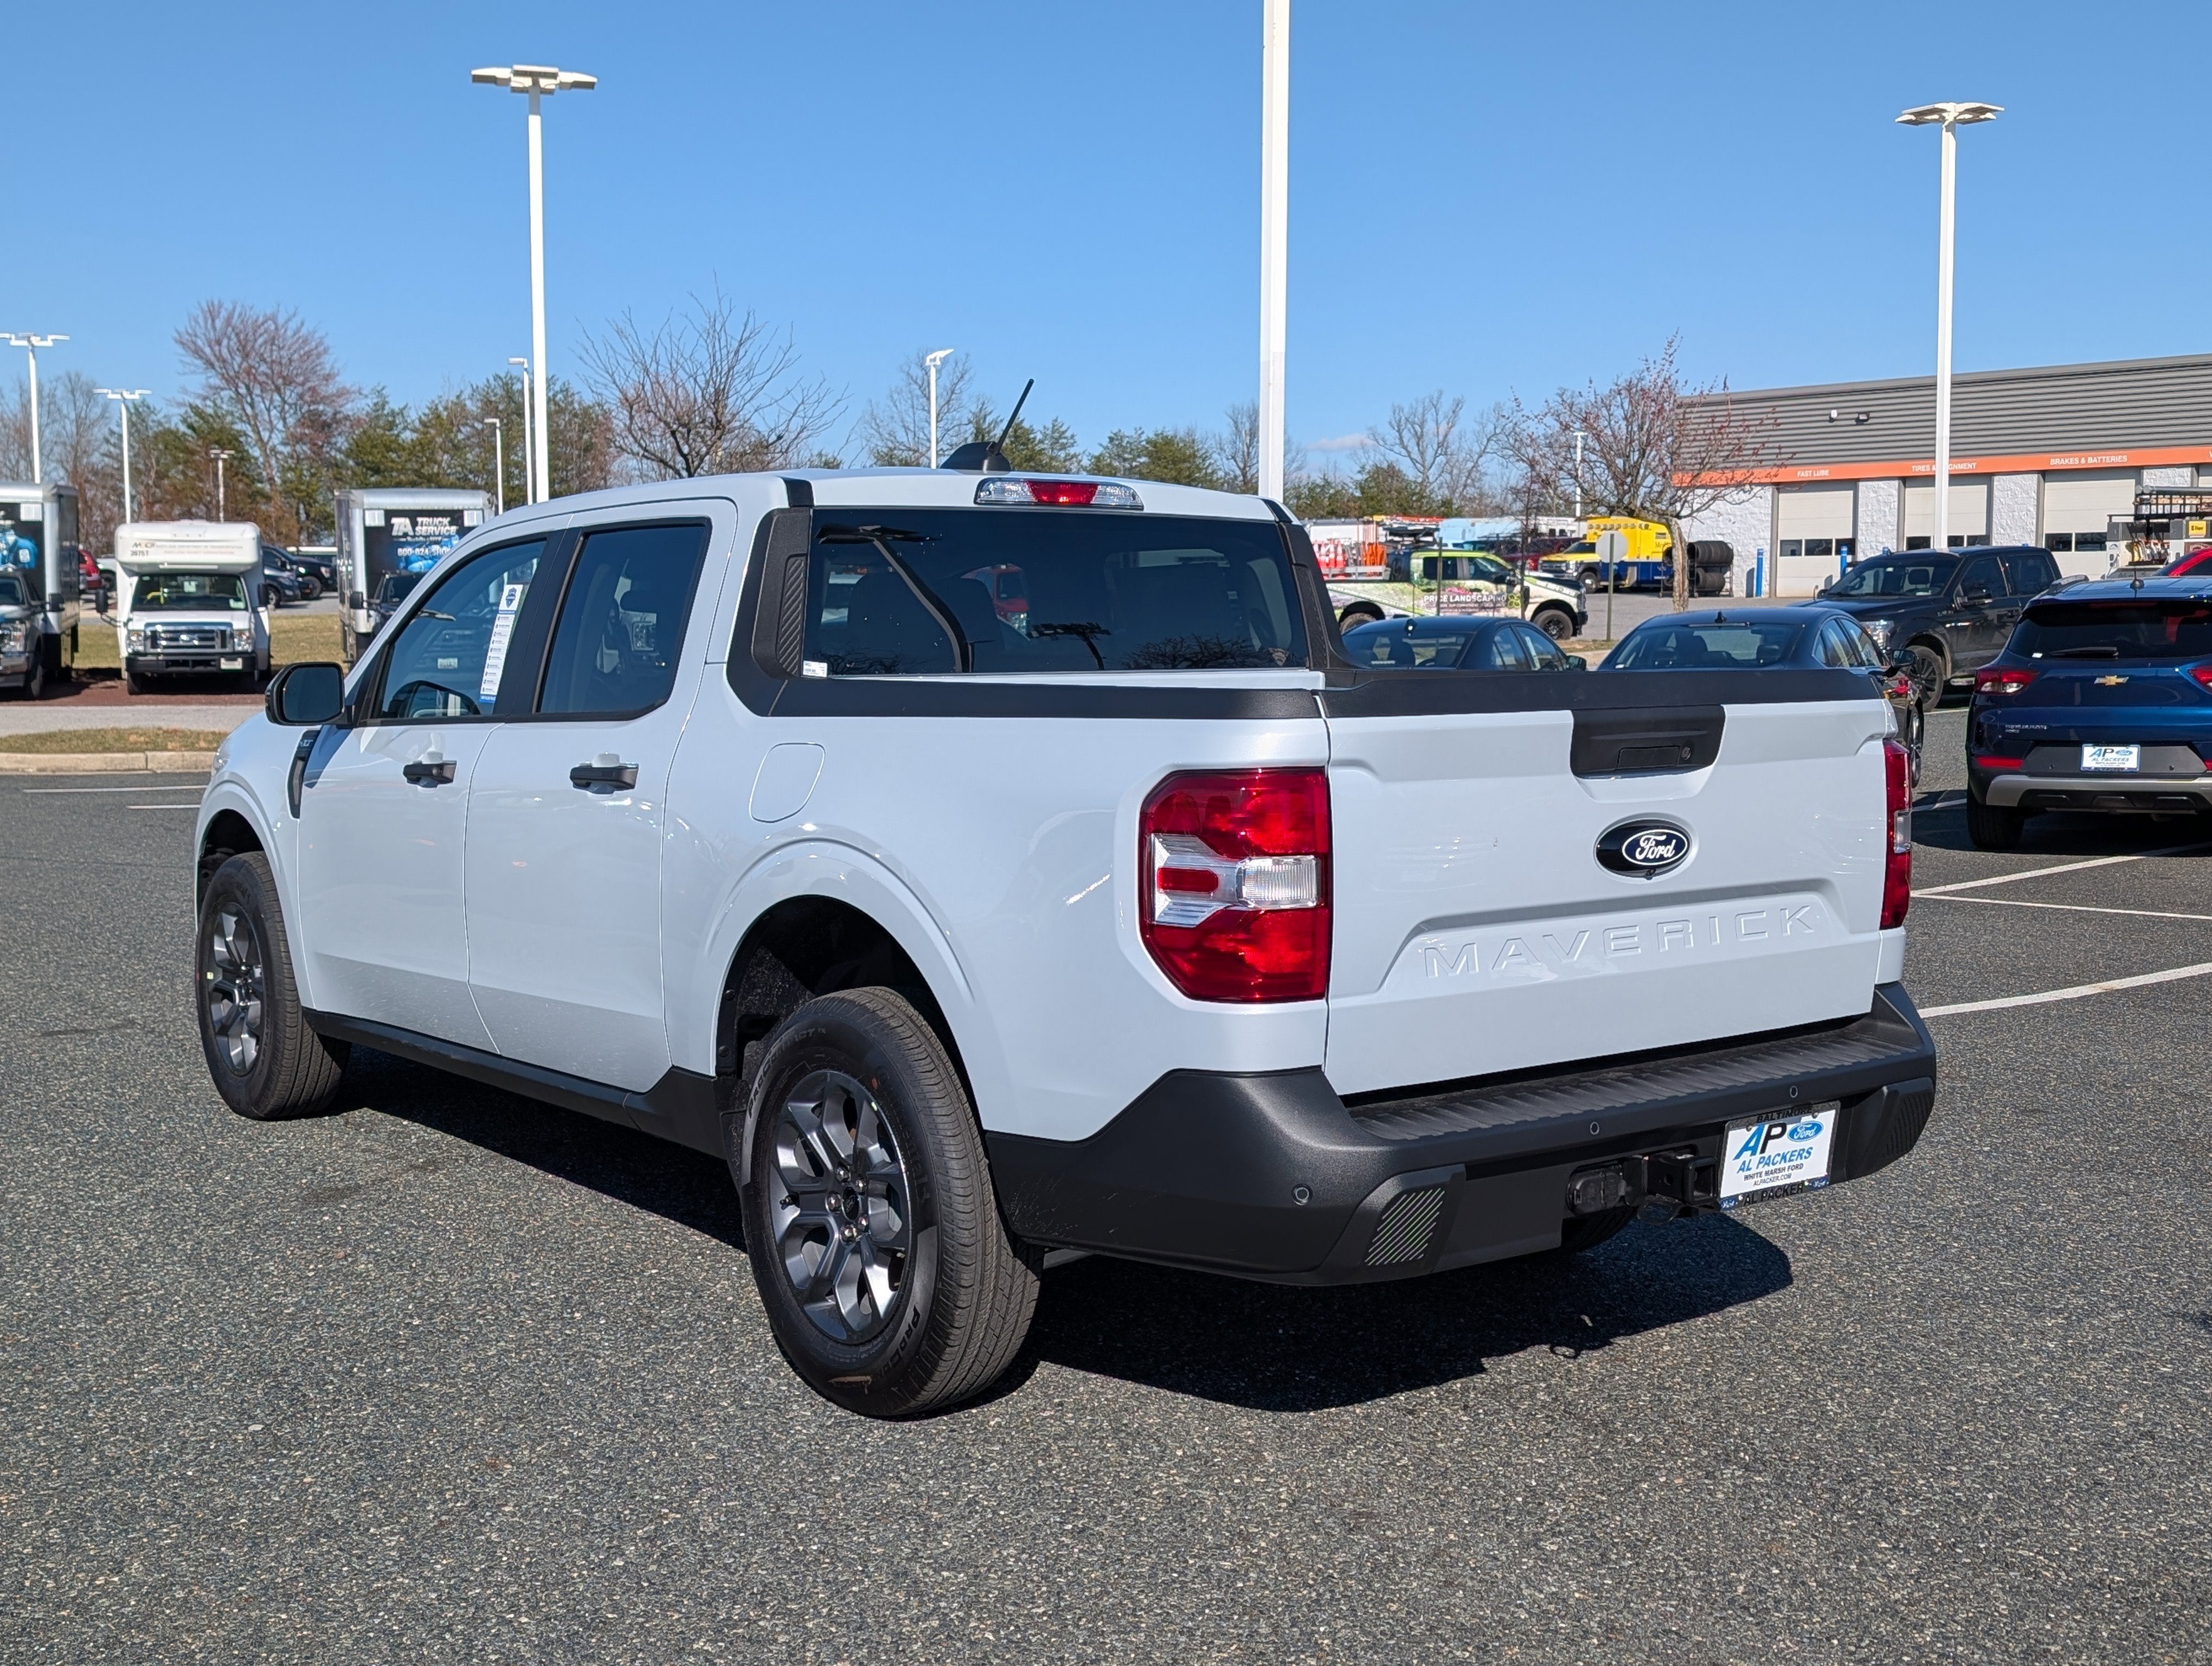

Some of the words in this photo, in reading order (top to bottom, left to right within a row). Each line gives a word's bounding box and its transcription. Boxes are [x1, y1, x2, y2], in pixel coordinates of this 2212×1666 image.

[2088, 455, 2127, 463] BATTERIES
[391, 517, 414, 536] TA
[415, 526, 456, 536] SERVICE
[416, 517, 451, 527] TRUCK
[2089, 748, 2114, 758] AP
[1636, 835, 1676, 860] Ford
[1424, 905, 1814, 978] MAVERICK
[1756, 1108, 1813, 1123] BALTIMORE
[1732, 1122, 1787, 1161] AP
[1793, 1124, 1816, 1139] Ford
[1737, 1159, 1752, 1174] AL
[1756, 1146, 1814, 1169] PACKERS
[1744, 1171, 1763, 1181] WHITE
[1764, 1168, 1786, 1176] MARSH
[1787, 1163, 1804, 1172] FORD
[1753, 1174, 1792, 1186] ALPACKER.COM
[1743, 1194, 1758, 1206] AL
[1761, 1184, 1804, 1201] PACKER
